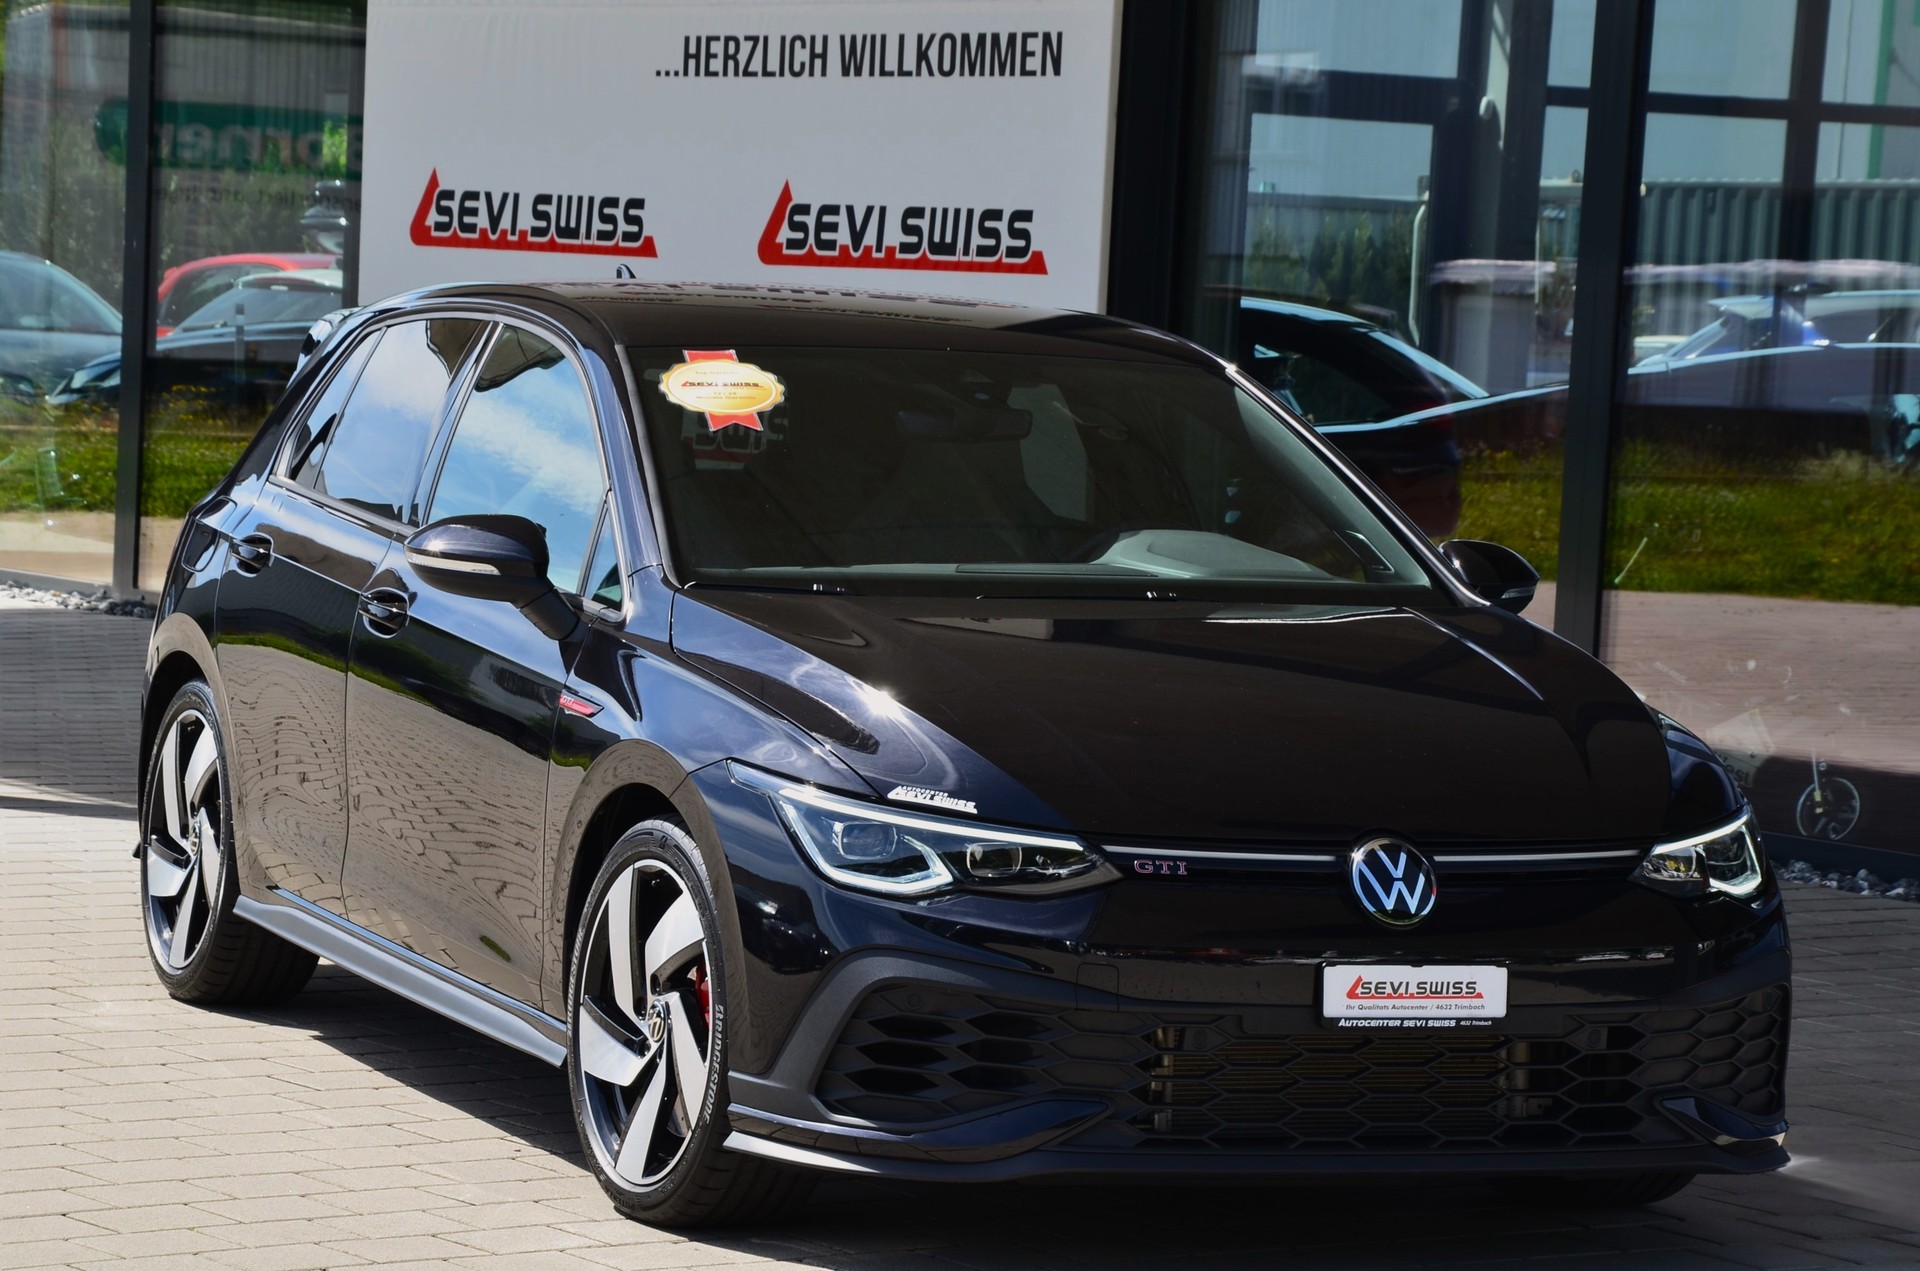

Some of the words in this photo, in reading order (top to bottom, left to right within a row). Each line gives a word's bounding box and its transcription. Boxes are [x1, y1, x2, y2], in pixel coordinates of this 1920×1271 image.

[839, 31, 1063, 77] WILLKOMMEN
[433, 189, 520, 237] SEVI
[530, 193, 646, 243] SWISS
[785, 203, 887, 253] SEVI
[898, 206, 1034, 259] SWISS
[1133, 859, 1188, 875] GTI
[1359, 981, 1410, 995] SEVI
[1415, 981, 1477, 995] SWISS
[1454, 1003, 1486, 1011] Trimbach
[1402, 1019, 1426, 1027] SEVI
[1427, 1019, 1457, 1027] SWISS
[704, 1004, 725, 1125] BRIDGESTONE
